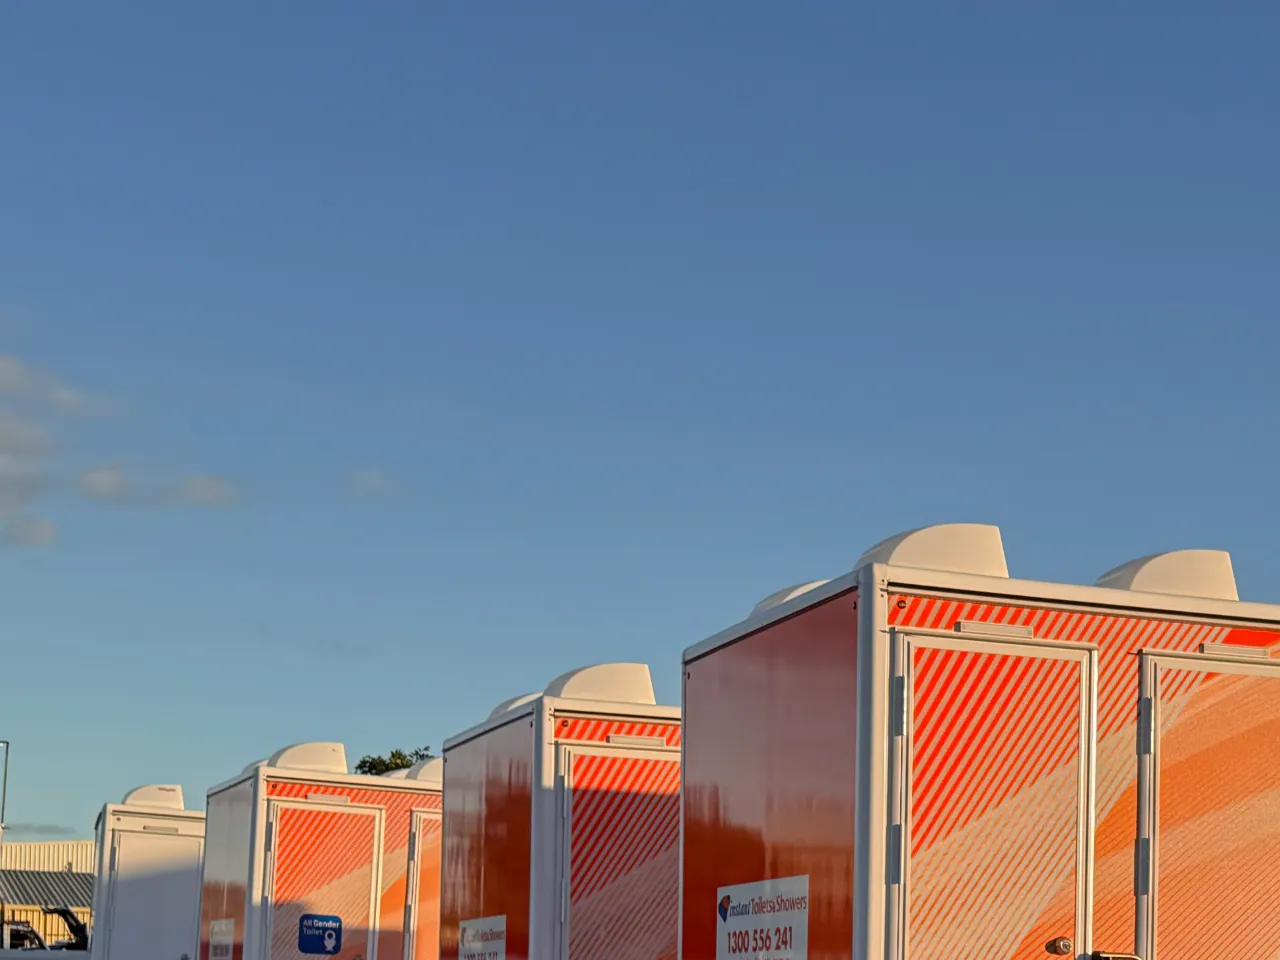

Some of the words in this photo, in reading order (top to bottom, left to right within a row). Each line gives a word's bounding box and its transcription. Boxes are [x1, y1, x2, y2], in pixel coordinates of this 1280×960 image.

[313, 919, 339, 928] Gender
[303, 927, 323, 935] Toilet
[727, 929, 750, 954] 1300
[752, 927, 772, 953] 556
[774, 926, 793, 951] 241
